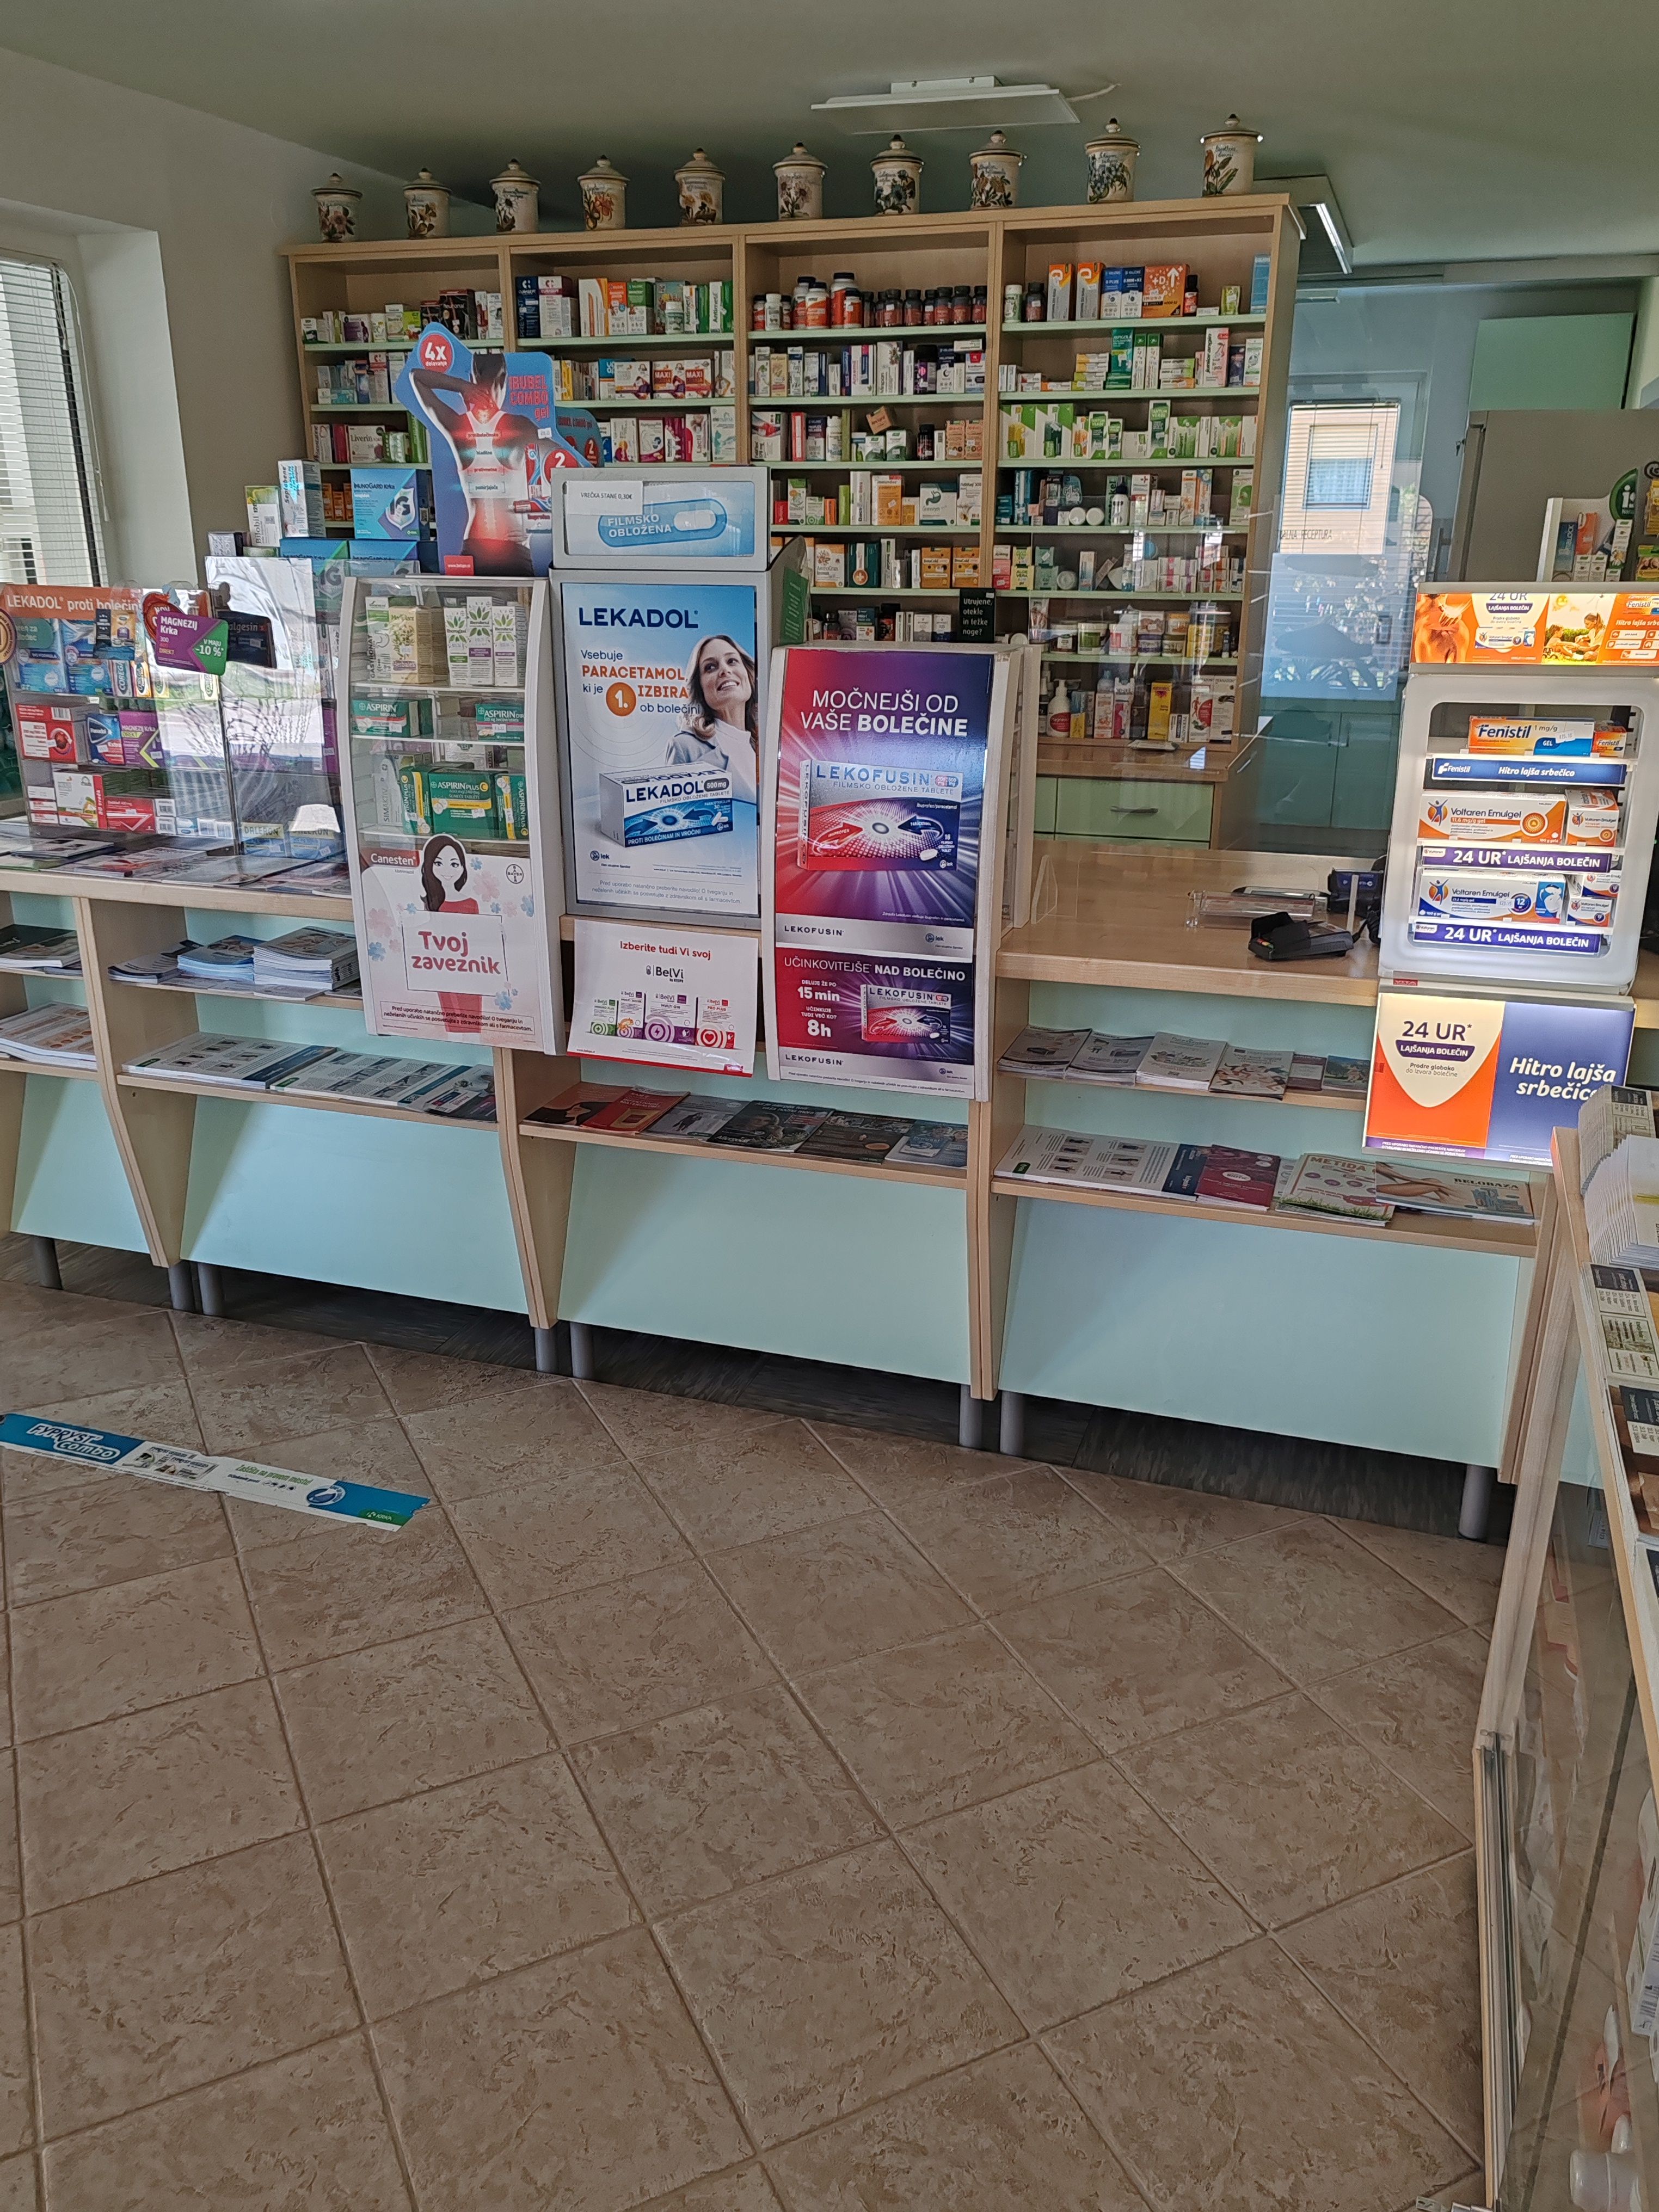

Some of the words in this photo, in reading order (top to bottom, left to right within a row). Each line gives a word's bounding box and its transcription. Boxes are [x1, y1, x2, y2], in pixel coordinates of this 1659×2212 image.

[425, 342, 447, 361] 4x
[509, 390, 549, 406] COMBO
[534, 405, 550, 420] gel
[607, 514, 659, 526] FILMSKO
[254, 516, 262, 544] Bilobil
[609, 524, 672, 538] OBLOŽENA
[67, 599, 94, 612] proti
[161, 616, 198, 630] MAGNEZIJ
[228, 622, 259, 633] algesin
[970, 617, 988, 625] težke
[160, 626, 178, 635] Krka
[963, 628, 982, 636] noge?
[581, 649, 623, 662] Vsebuje
[582, 665, 689, 682] PARACETAMOL,
[583, 683, 591, 693] ki
[593, 685, 603, 695] je
[615, 690, 628, 708] 1.
[637, 685, 689, 698] IZBIRA
[813, 687, 919, 712] MOČNEJŠI
[926, 695, 958, 714] OD
[366, 703, 397, 712] ASPIRIN
[484, 710, 517, 718] ASPIRIN
[640, 703, 654, 712] ob
[658, 703, 701, 715] bolečini
[801, 709, 852, 731] VAŠE
[857, 712, 968, 736] BOLEČINE
[1478, 724, 1532, 739] Fenistil
[816, 765, 932, 786] LEKOFUSIN
[1498, 766, 1519, 775] Hitro
[1521, 766, 1540, 777] lajša
[1541, 767, 1575, 777] srbečico
[626, 781, 703, 803] LEKADOL
[833, 781, 871, 790] FILMSKO
[874, 783, 918, 793] OBLOŽENE
[519, 788, 527, 816] ASPIRIN
[1451, 808, 1486, 816] Voltaren
[1488, 809, 1522, 819] Emulgel
[644, 834, 674, 843] BOLEČINAM
[681, 828, 701, 837] VROČINI
[371, 853, 416, 866] Canesten
[1453, 850, 1474, 863] 24
[1508, 854, 1554, 867] LAJŠANJA
[1557, 856, 1601, 868] BOLEČIN
[1482, 889, 1510, 899] Emulgel
[784, 925, 844, 936] LEKOFUSIN
[1444, 927, 1465, 940] 24
[1498, 932, 1544, 945] LAJŠANJA
[1546, 935, 1589, 948] BOLEČIN
[417, 930, 469, 957] Tvoj
[620, 941, 656, 952] Izberite
[659, 945, 678, 955] tudi
[679, 947, 690, 956] Vi
[692, 949, 711, 960] svoj
[411, 956, 501, 974] zaveznik
[655, 966, 684, 979] BelVi
[875, 964, 900, 975] NAD
[903, 967, 965, 981] BOLEČINO
[797, 987, 813, 999] 15
[815, 990, 840, 1001] min
[870, 987, 935, 1000] LEKOFUSIN
[403, 1006, 423, 1015] uporabo
[499, 1023, 532, 1031] farmacevtom.
[1402, 1021, 1429, 1038] 24
[1400, 1044, 1435, 1054] LAJŠANJA
[1436, 1047, 1468, 1057] BOLEČIN
[785, 1054, 844, 1065] LEKOFUSIN
[1510, 1057, 1563, 1079] Hitro
[1567, 1061, 1617, 1085] lajša
[1310, 1156, 1367, 1172] METIDA
[59, 1440, 114, 1457] combo
